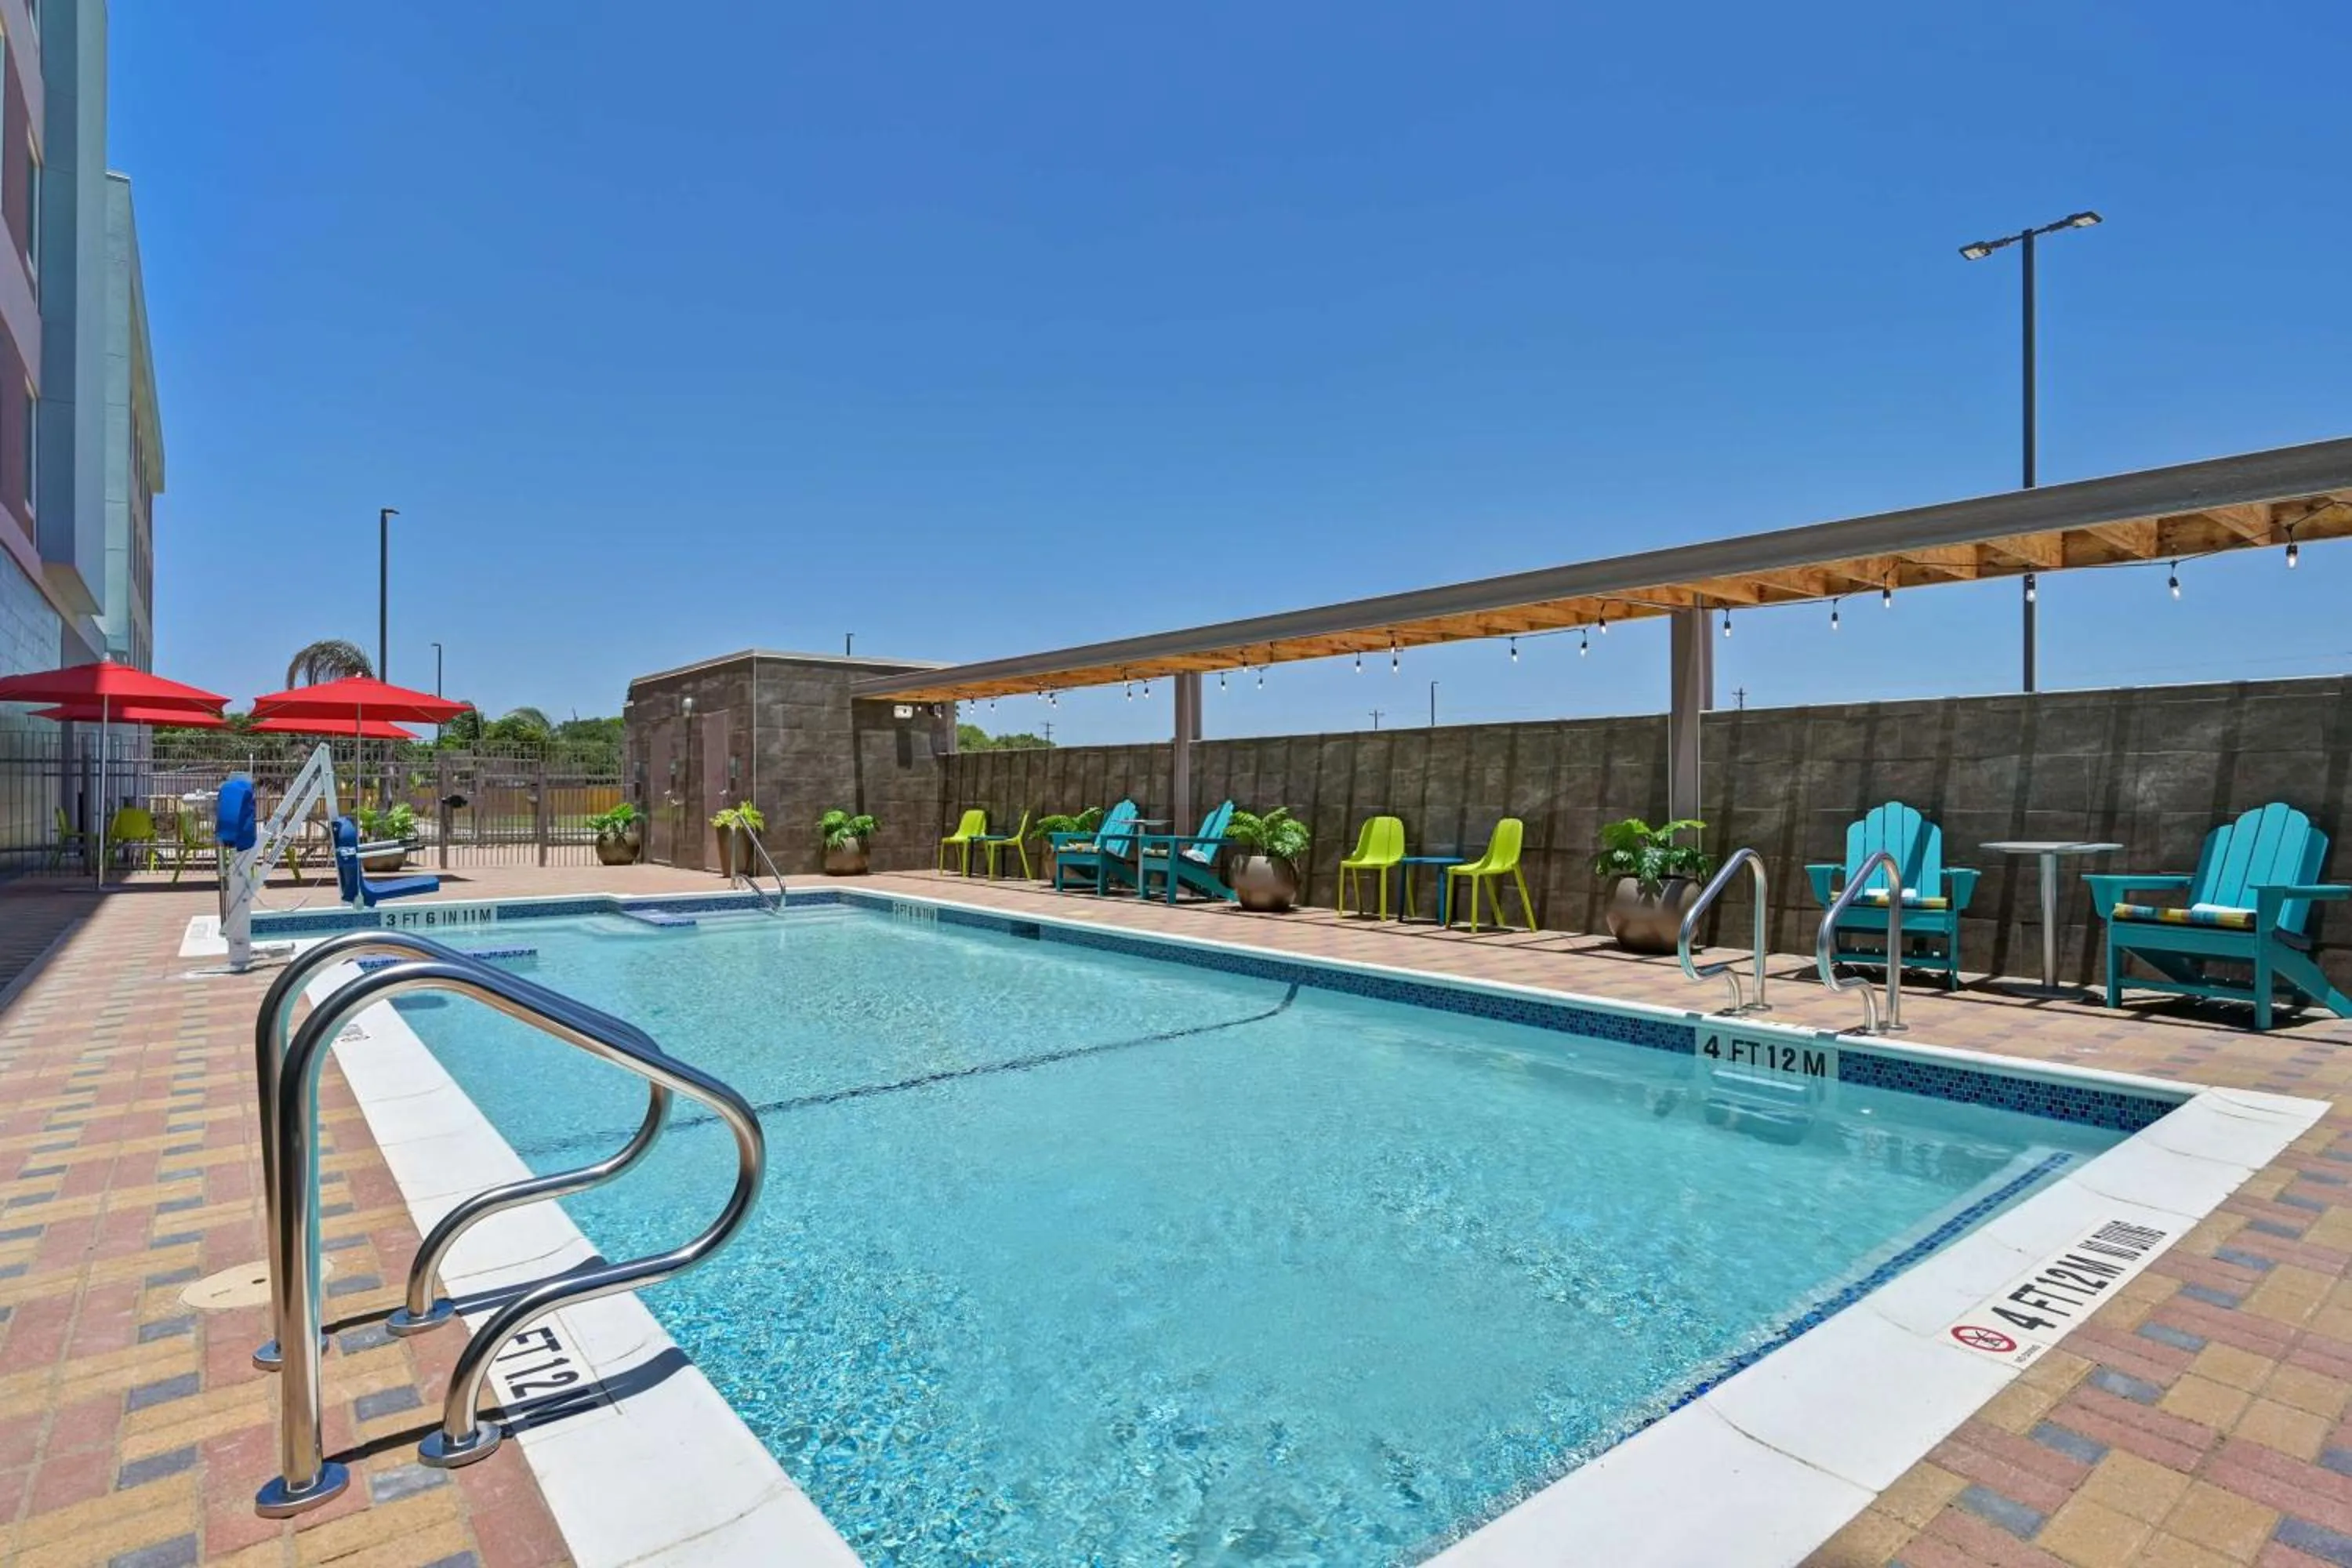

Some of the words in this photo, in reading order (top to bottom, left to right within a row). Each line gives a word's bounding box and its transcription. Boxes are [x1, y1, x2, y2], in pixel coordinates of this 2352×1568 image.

[385, 913, 395, 927] 3
[402, 913, 419, 927] FT
[426, 912, 435, 924] 6
[443, 909, 457, 925] IN
[1704, 1035, 1720, 1059] 4
[1731, 1040, 1760, 1065] FT
[2007, 1283, 2083, 1317] FT
[1991, 1306, 2056, 1330] 4
